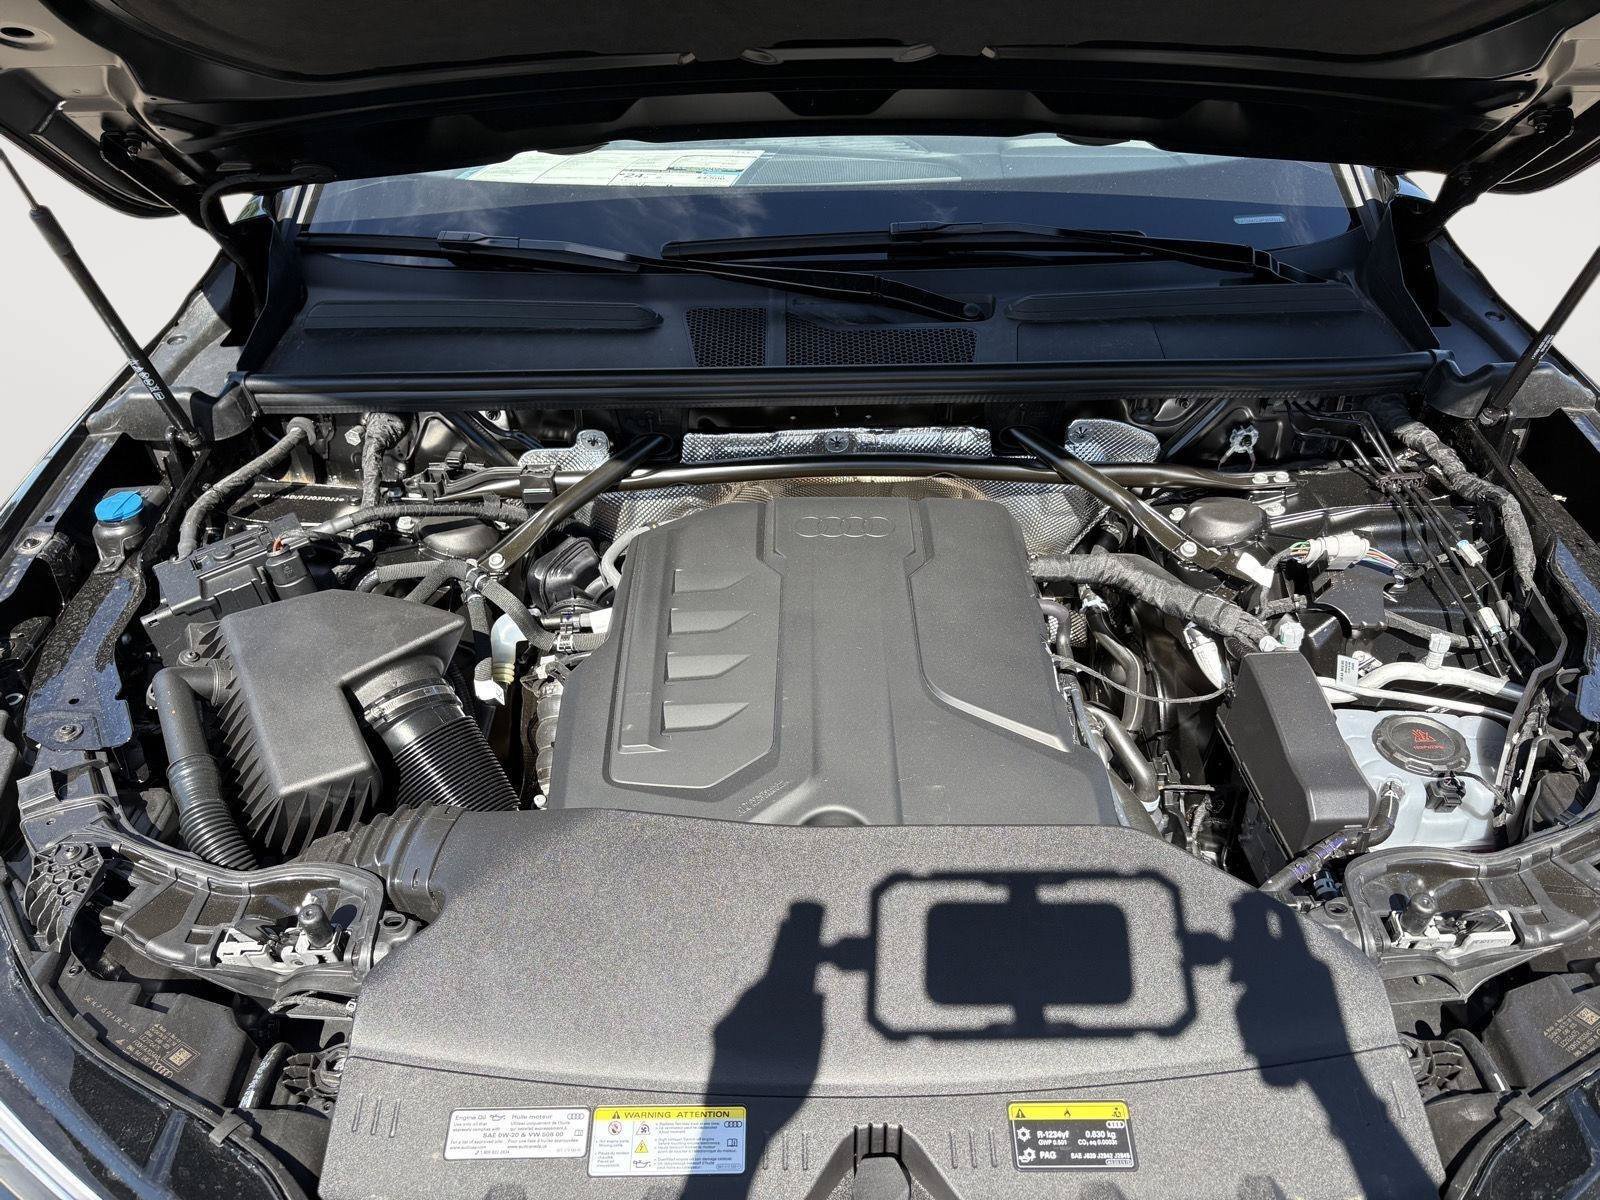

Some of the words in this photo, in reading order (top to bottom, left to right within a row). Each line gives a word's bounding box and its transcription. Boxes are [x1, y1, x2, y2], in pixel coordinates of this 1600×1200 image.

[624, 1111, 671, 1119] WARNING
[676, 1110, 730, 1118] ATTENTION
[1037, 1130, 1069, 1140] R-1234yf
[1106, 1130, 1117, 1140] kg
[1039, 1150, 1057, 1159] PAG
